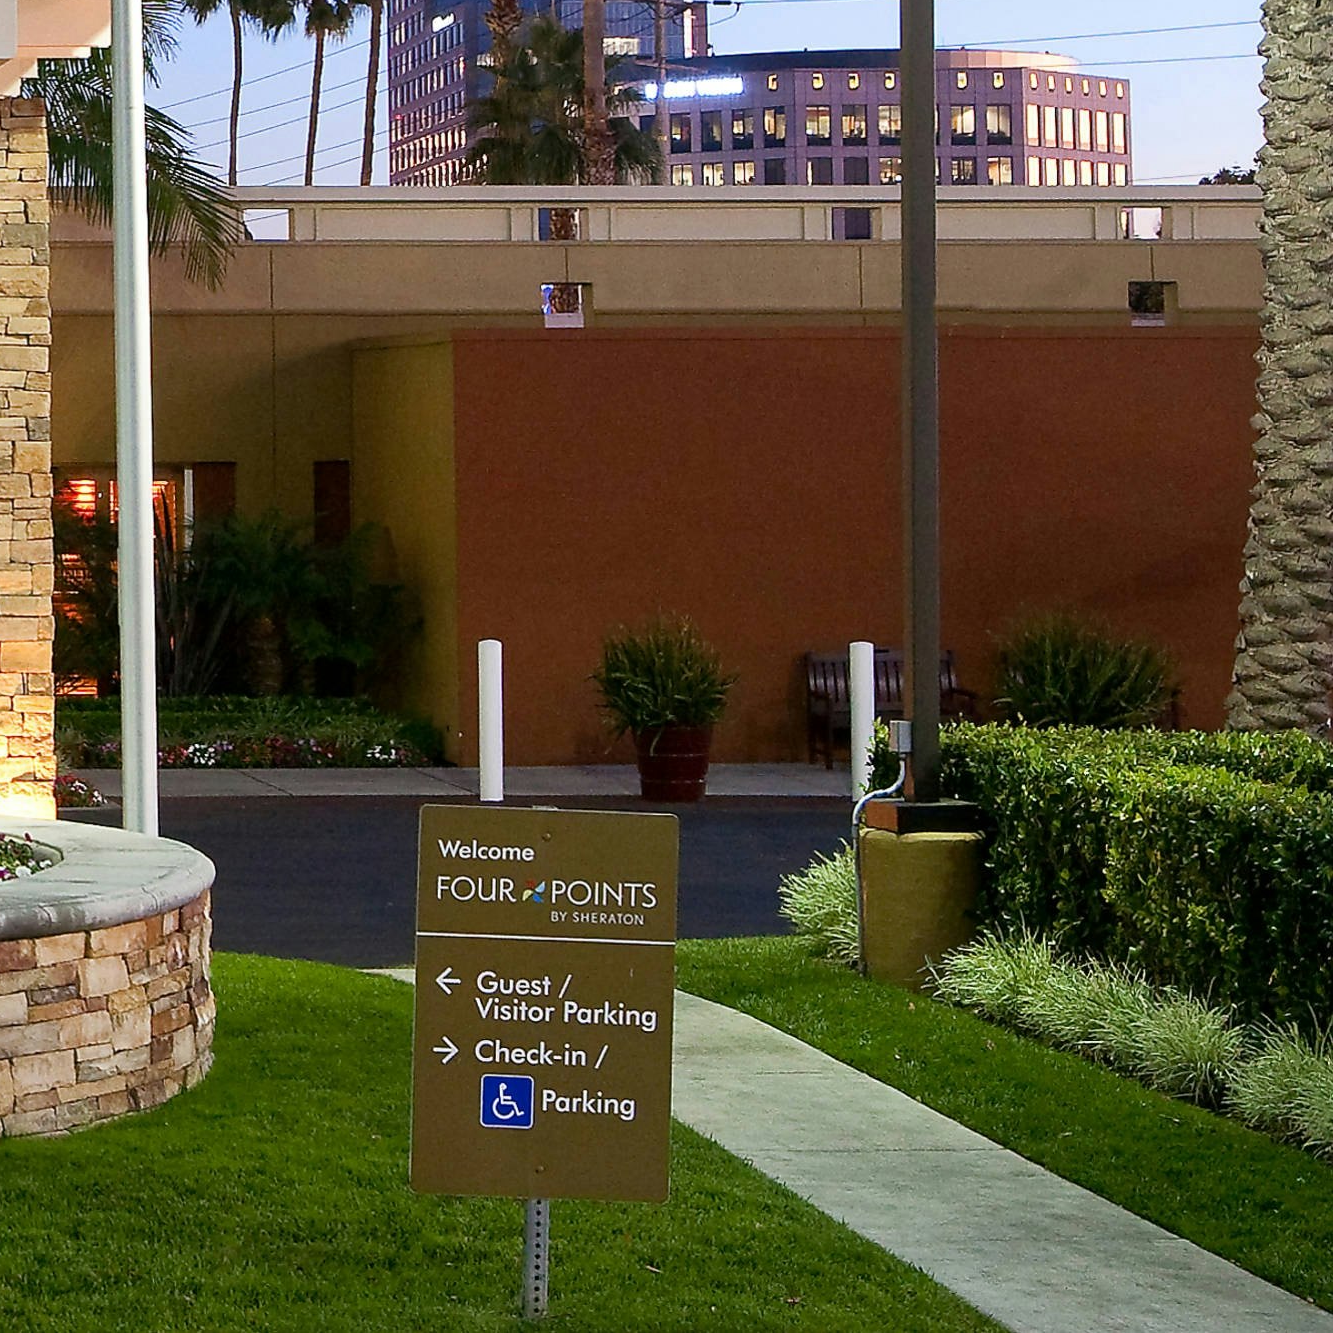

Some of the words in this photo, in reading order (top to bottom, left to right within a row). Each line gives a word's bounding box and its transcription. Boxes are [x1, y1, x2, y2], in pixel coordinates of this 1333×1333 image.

[438, 839, 535, 862] Welcome
[437, 875, 517, 903] FOUR
[551, 879, 657, 909] POINTS
[550, 910, 568, 923] BY
[572, 911, 644, 926] SHERATON
[476, 970, 552, 996] Guest
[475, 997, 556, 1023] Visitor
[563, 1000, 657, 1032] Parking
[474, 1039, 587, 1067] Check-in
[542, 1089, 635, 1121] Parking
